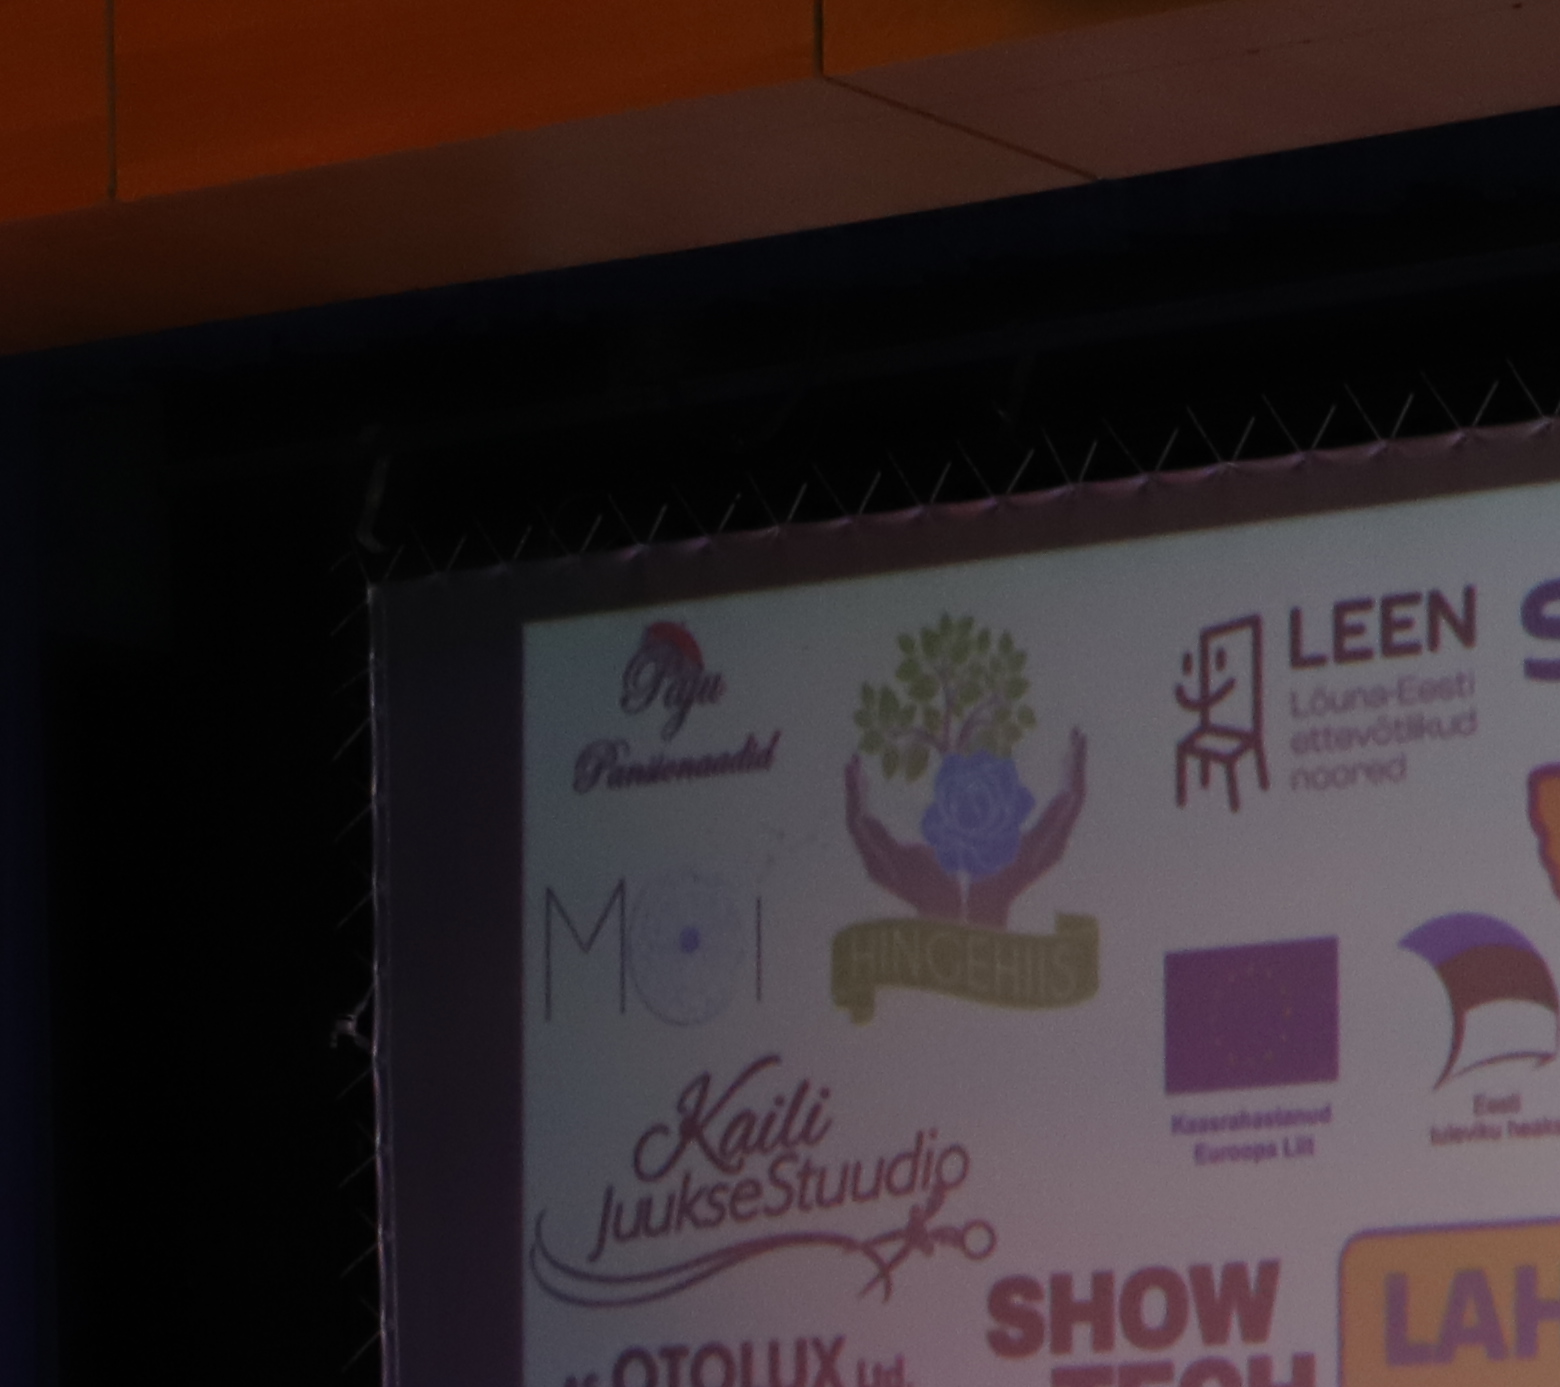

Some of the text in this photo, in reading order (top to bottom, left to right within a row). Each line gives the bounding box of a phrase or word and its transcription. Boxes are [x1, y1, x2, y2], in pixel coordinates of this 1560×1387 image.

[1288, 581, 1478, 671] LEEN
[1288, 755, 1408, 794] noored
[632, 1053, 834, 1183] Kaili
[985, 1258, 1281, 1360] SHOW
